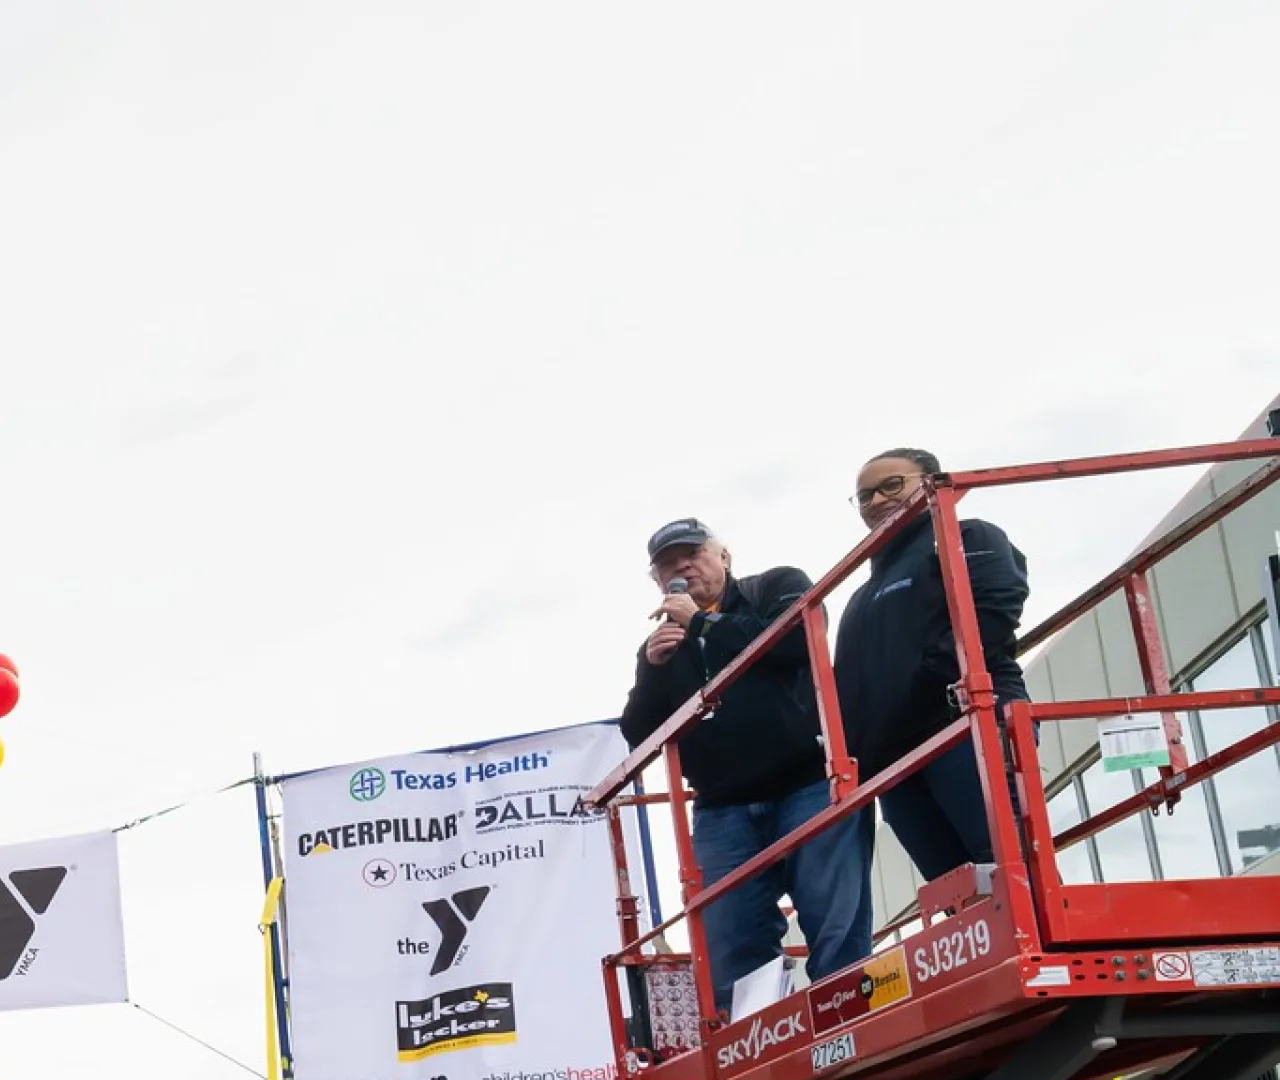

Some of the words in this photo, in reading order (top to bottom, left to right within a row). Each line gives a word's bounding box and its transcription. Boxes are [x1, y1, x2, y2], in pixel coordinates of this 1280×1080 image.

[391, 769, 456, 791] Texas
[465, 752, 548, 783] Health
[298, 811, 459, 857] CATERPILLAR
[400, 860, 456, 883] Texas
[460, 840, 545, 870] Capital
[16, 947, 39, 976] YMCA
[397, 938, 429, 955] the
[914, 918, 991, 983] SJ3219
[399, 990, 511, 1028] luke's
[414, 1019, 500, 1045] locker
[717, 1011, 806, 1069] SKYJACK
